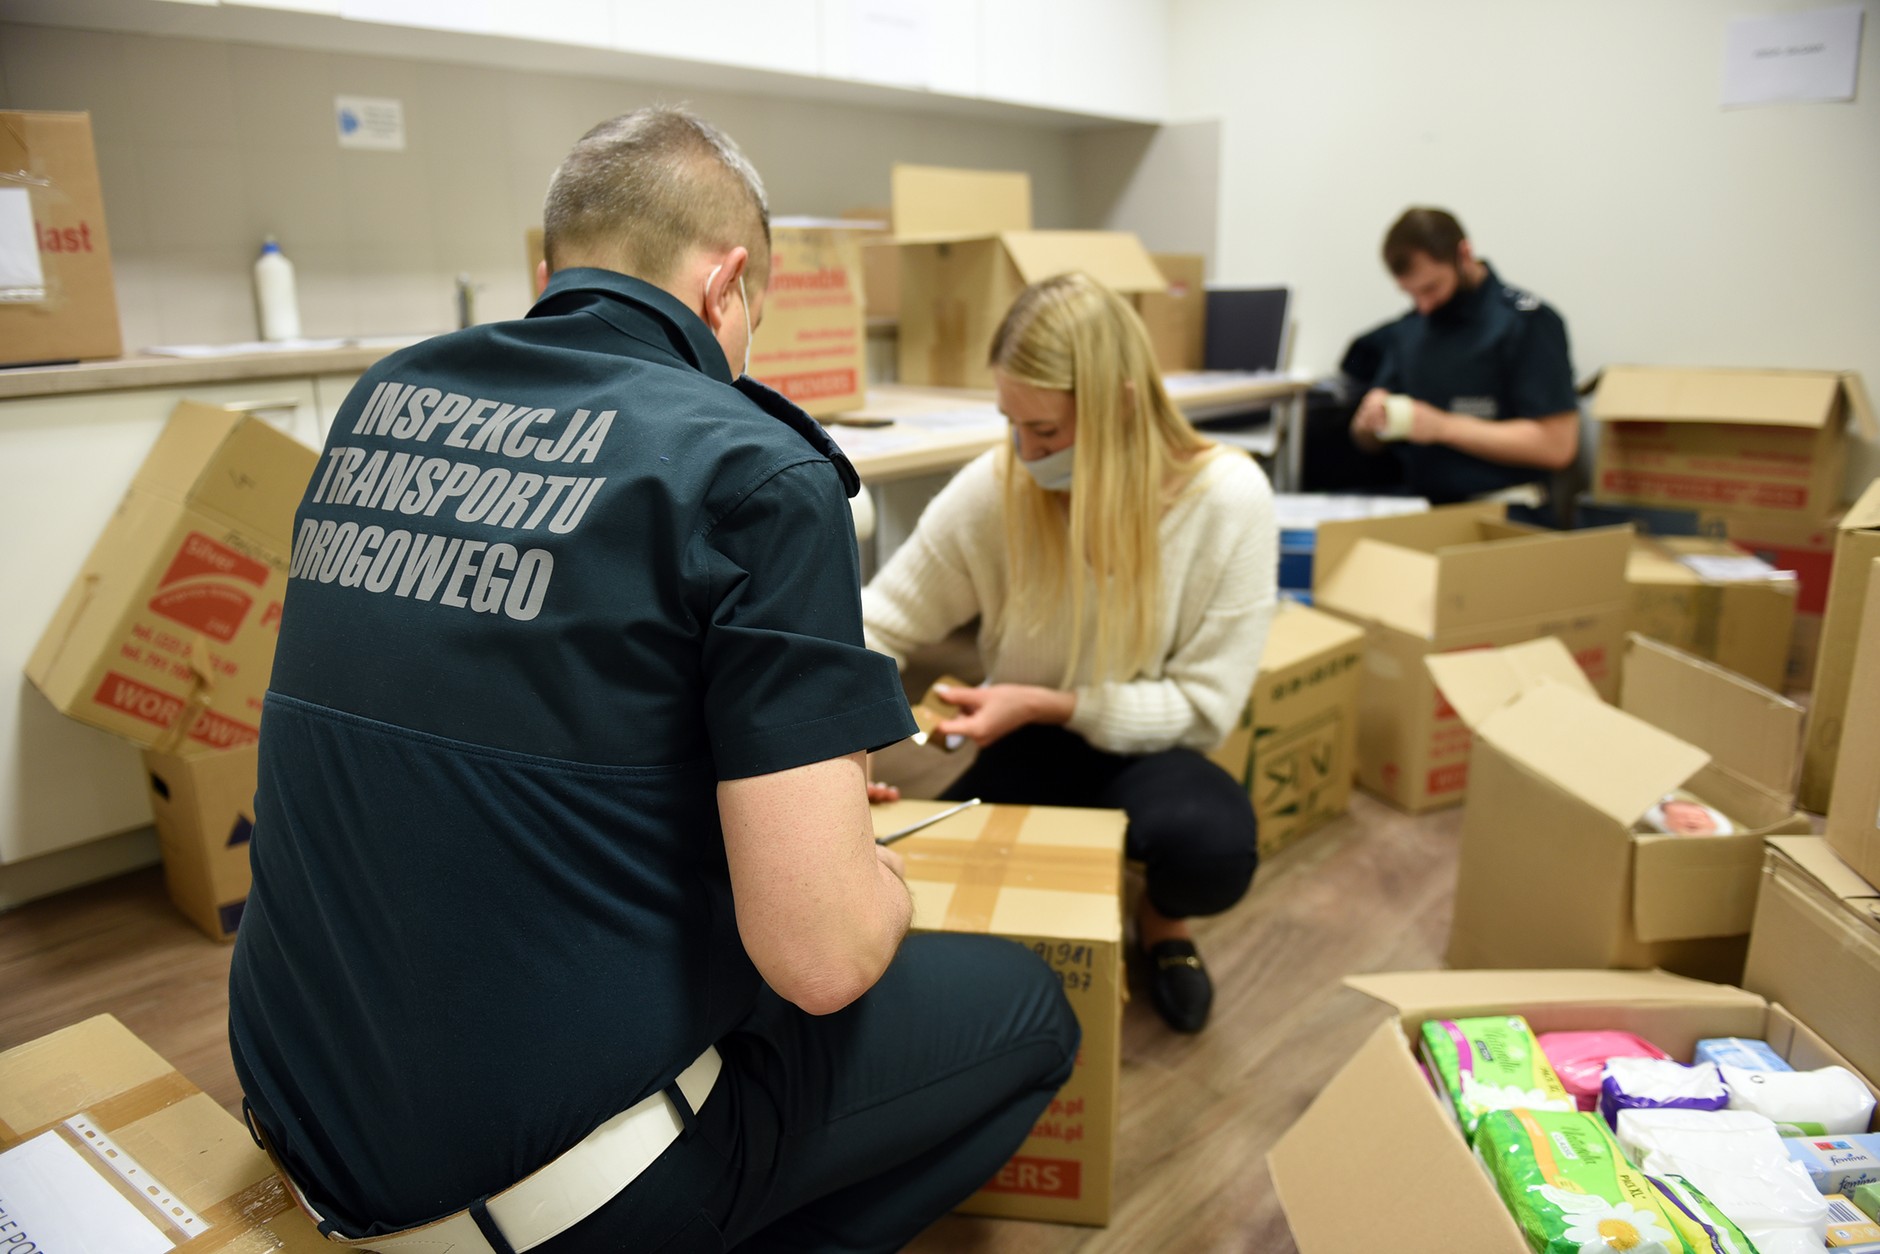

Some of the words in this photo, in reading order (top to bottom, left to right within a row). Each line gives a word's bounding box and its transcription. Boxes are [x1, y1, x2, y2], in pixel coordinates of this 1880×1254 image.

[35, 219, 94, 254] last
[351, 381, 618, 464] INSPEKCJA
[312, 446, 607, 534] TRANSPORTU
[289, 517, 555, 622] DROGOWEGO
[995, 1163, 1063, 1192] ERS
